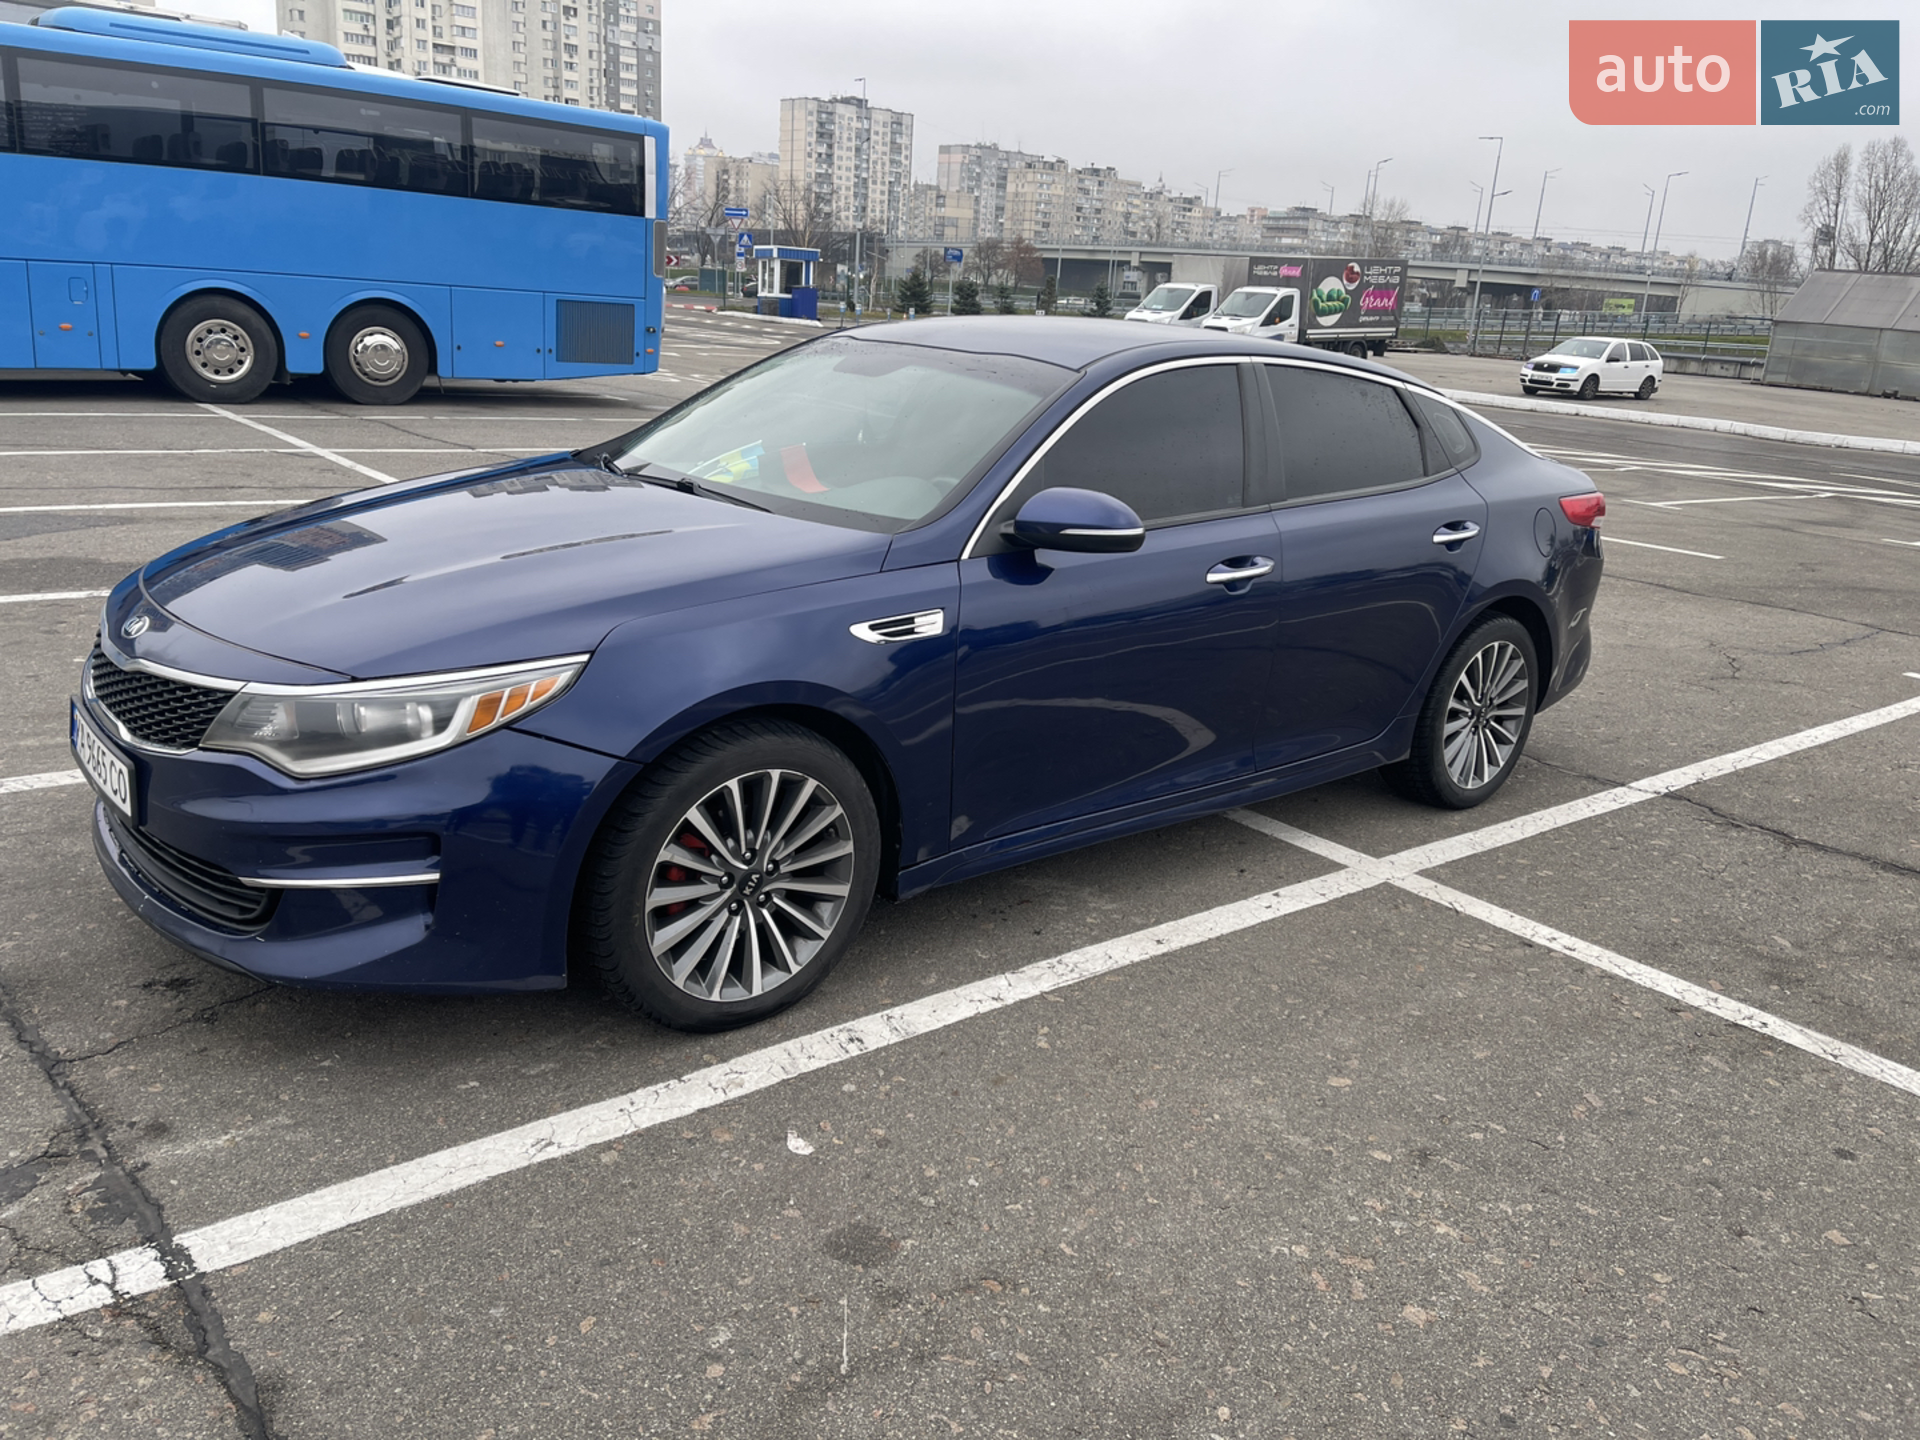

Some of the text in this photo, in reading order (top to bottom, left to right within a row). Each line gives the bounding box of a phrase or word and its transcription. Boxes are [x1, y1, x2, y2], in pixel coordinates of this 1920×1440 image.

[1364, 266, 1402, 275] ЦЕНТР
[1360, 285, 1400, 315] Grand
[110, 759, 128, 805] CO
[742, 873, 761, 896] KIA
